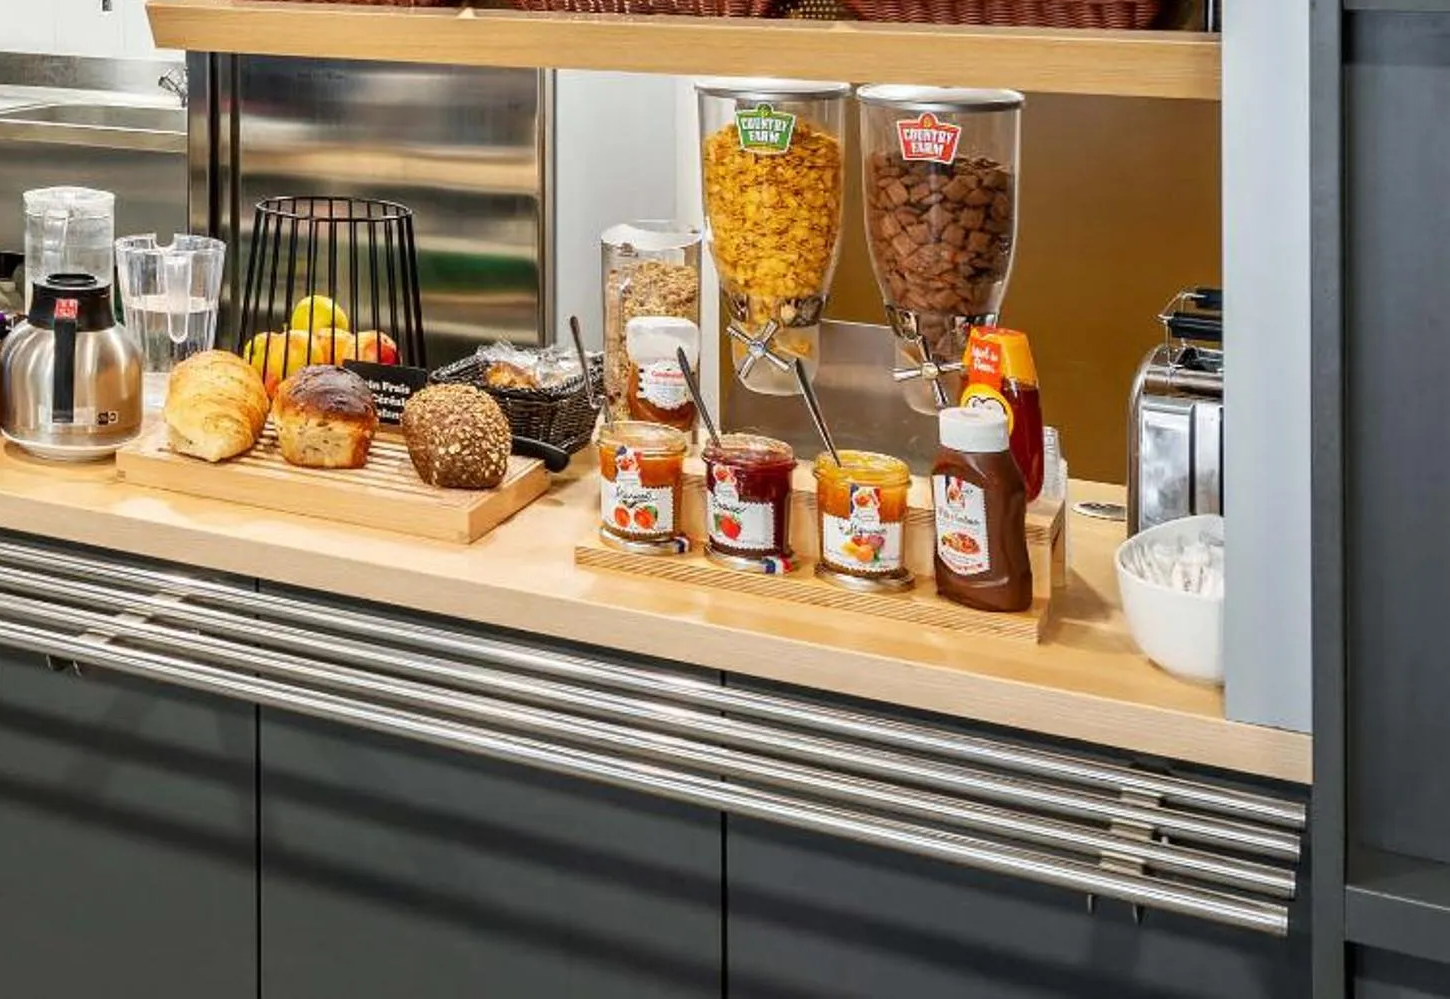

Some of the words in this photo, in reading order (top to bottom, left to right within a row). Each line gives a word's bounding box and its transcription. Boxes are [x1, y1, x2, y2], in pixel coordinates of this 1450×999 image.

[740, 116, 789, 132] COUNTRY
[749, 129, 781, 144] FARM
[902, 127, 954, 145] COUNTRY
[911, 141, 945, 157] FARM
[382, 381, 410, 393] Frais
